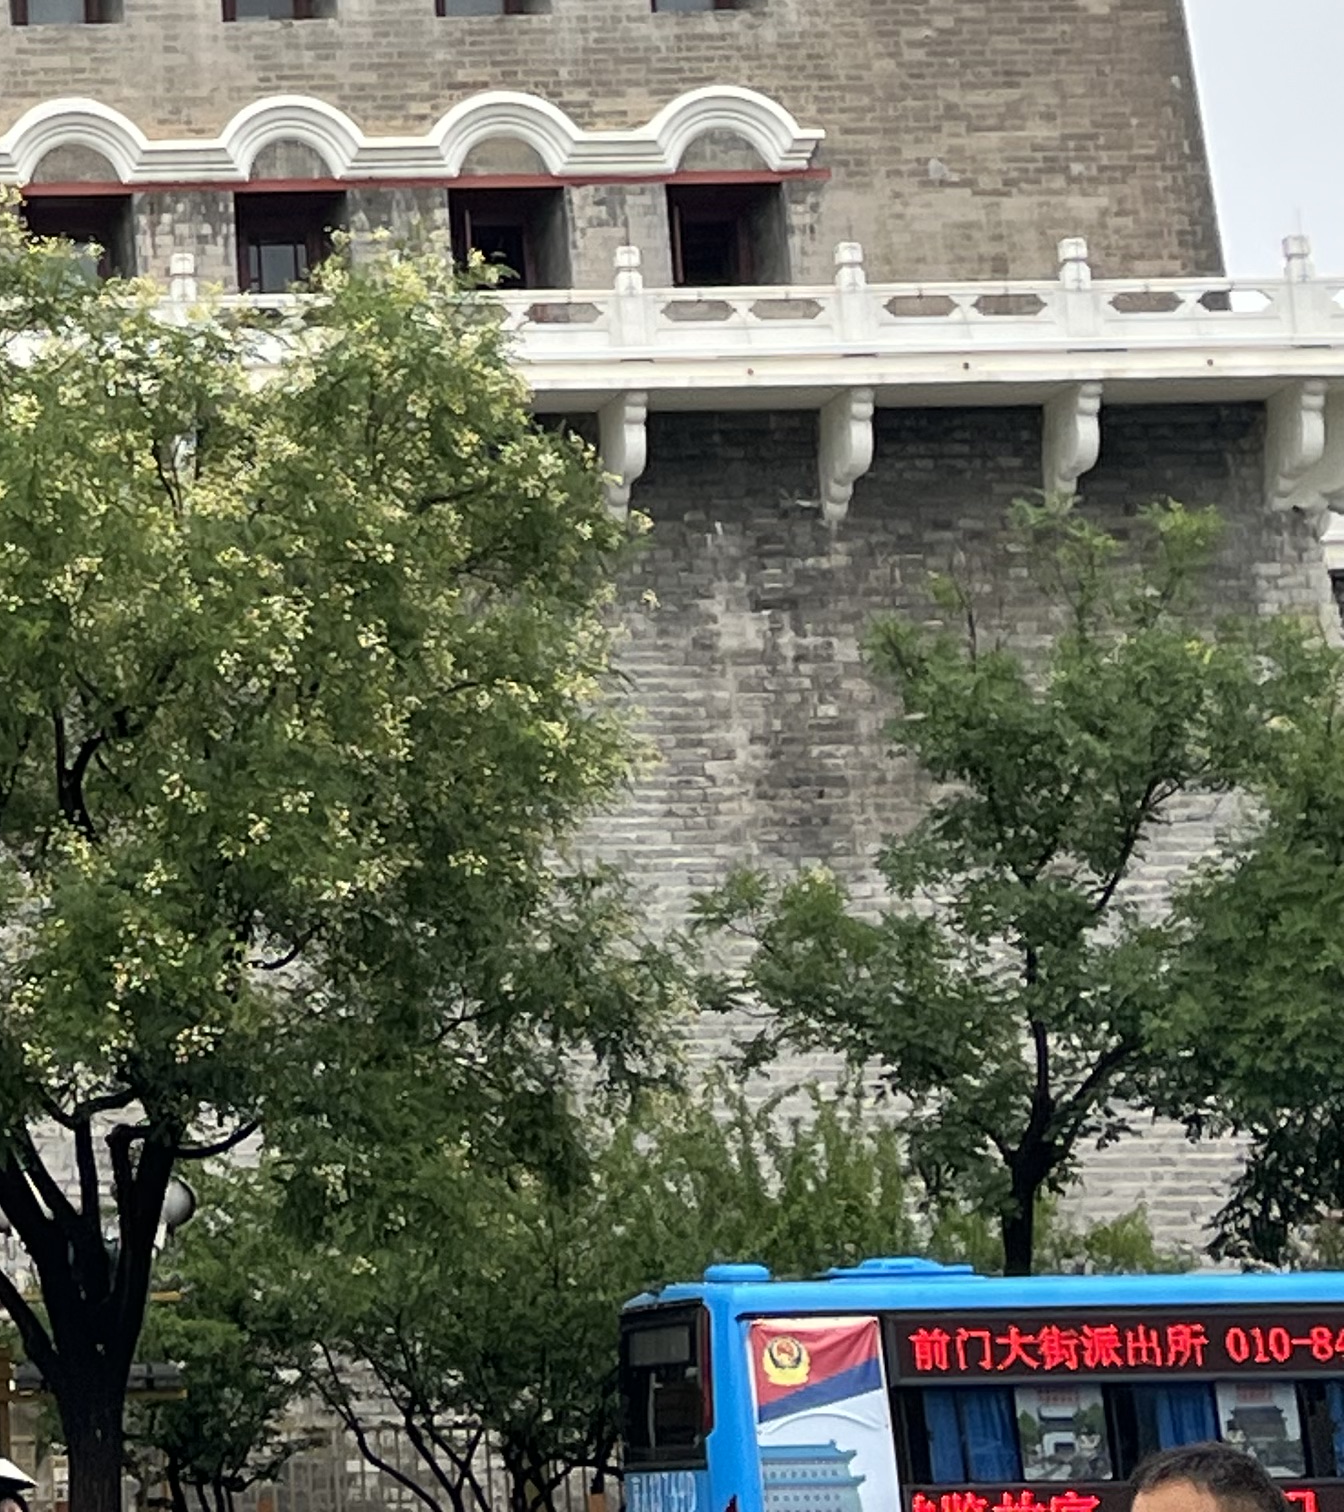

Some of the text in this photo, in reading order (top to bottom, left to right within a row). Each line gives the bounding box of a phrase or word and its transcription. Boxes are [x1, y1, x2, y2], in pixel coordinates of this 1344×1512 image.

[909, 1323, 1209, 1372] 前门大街派出所
